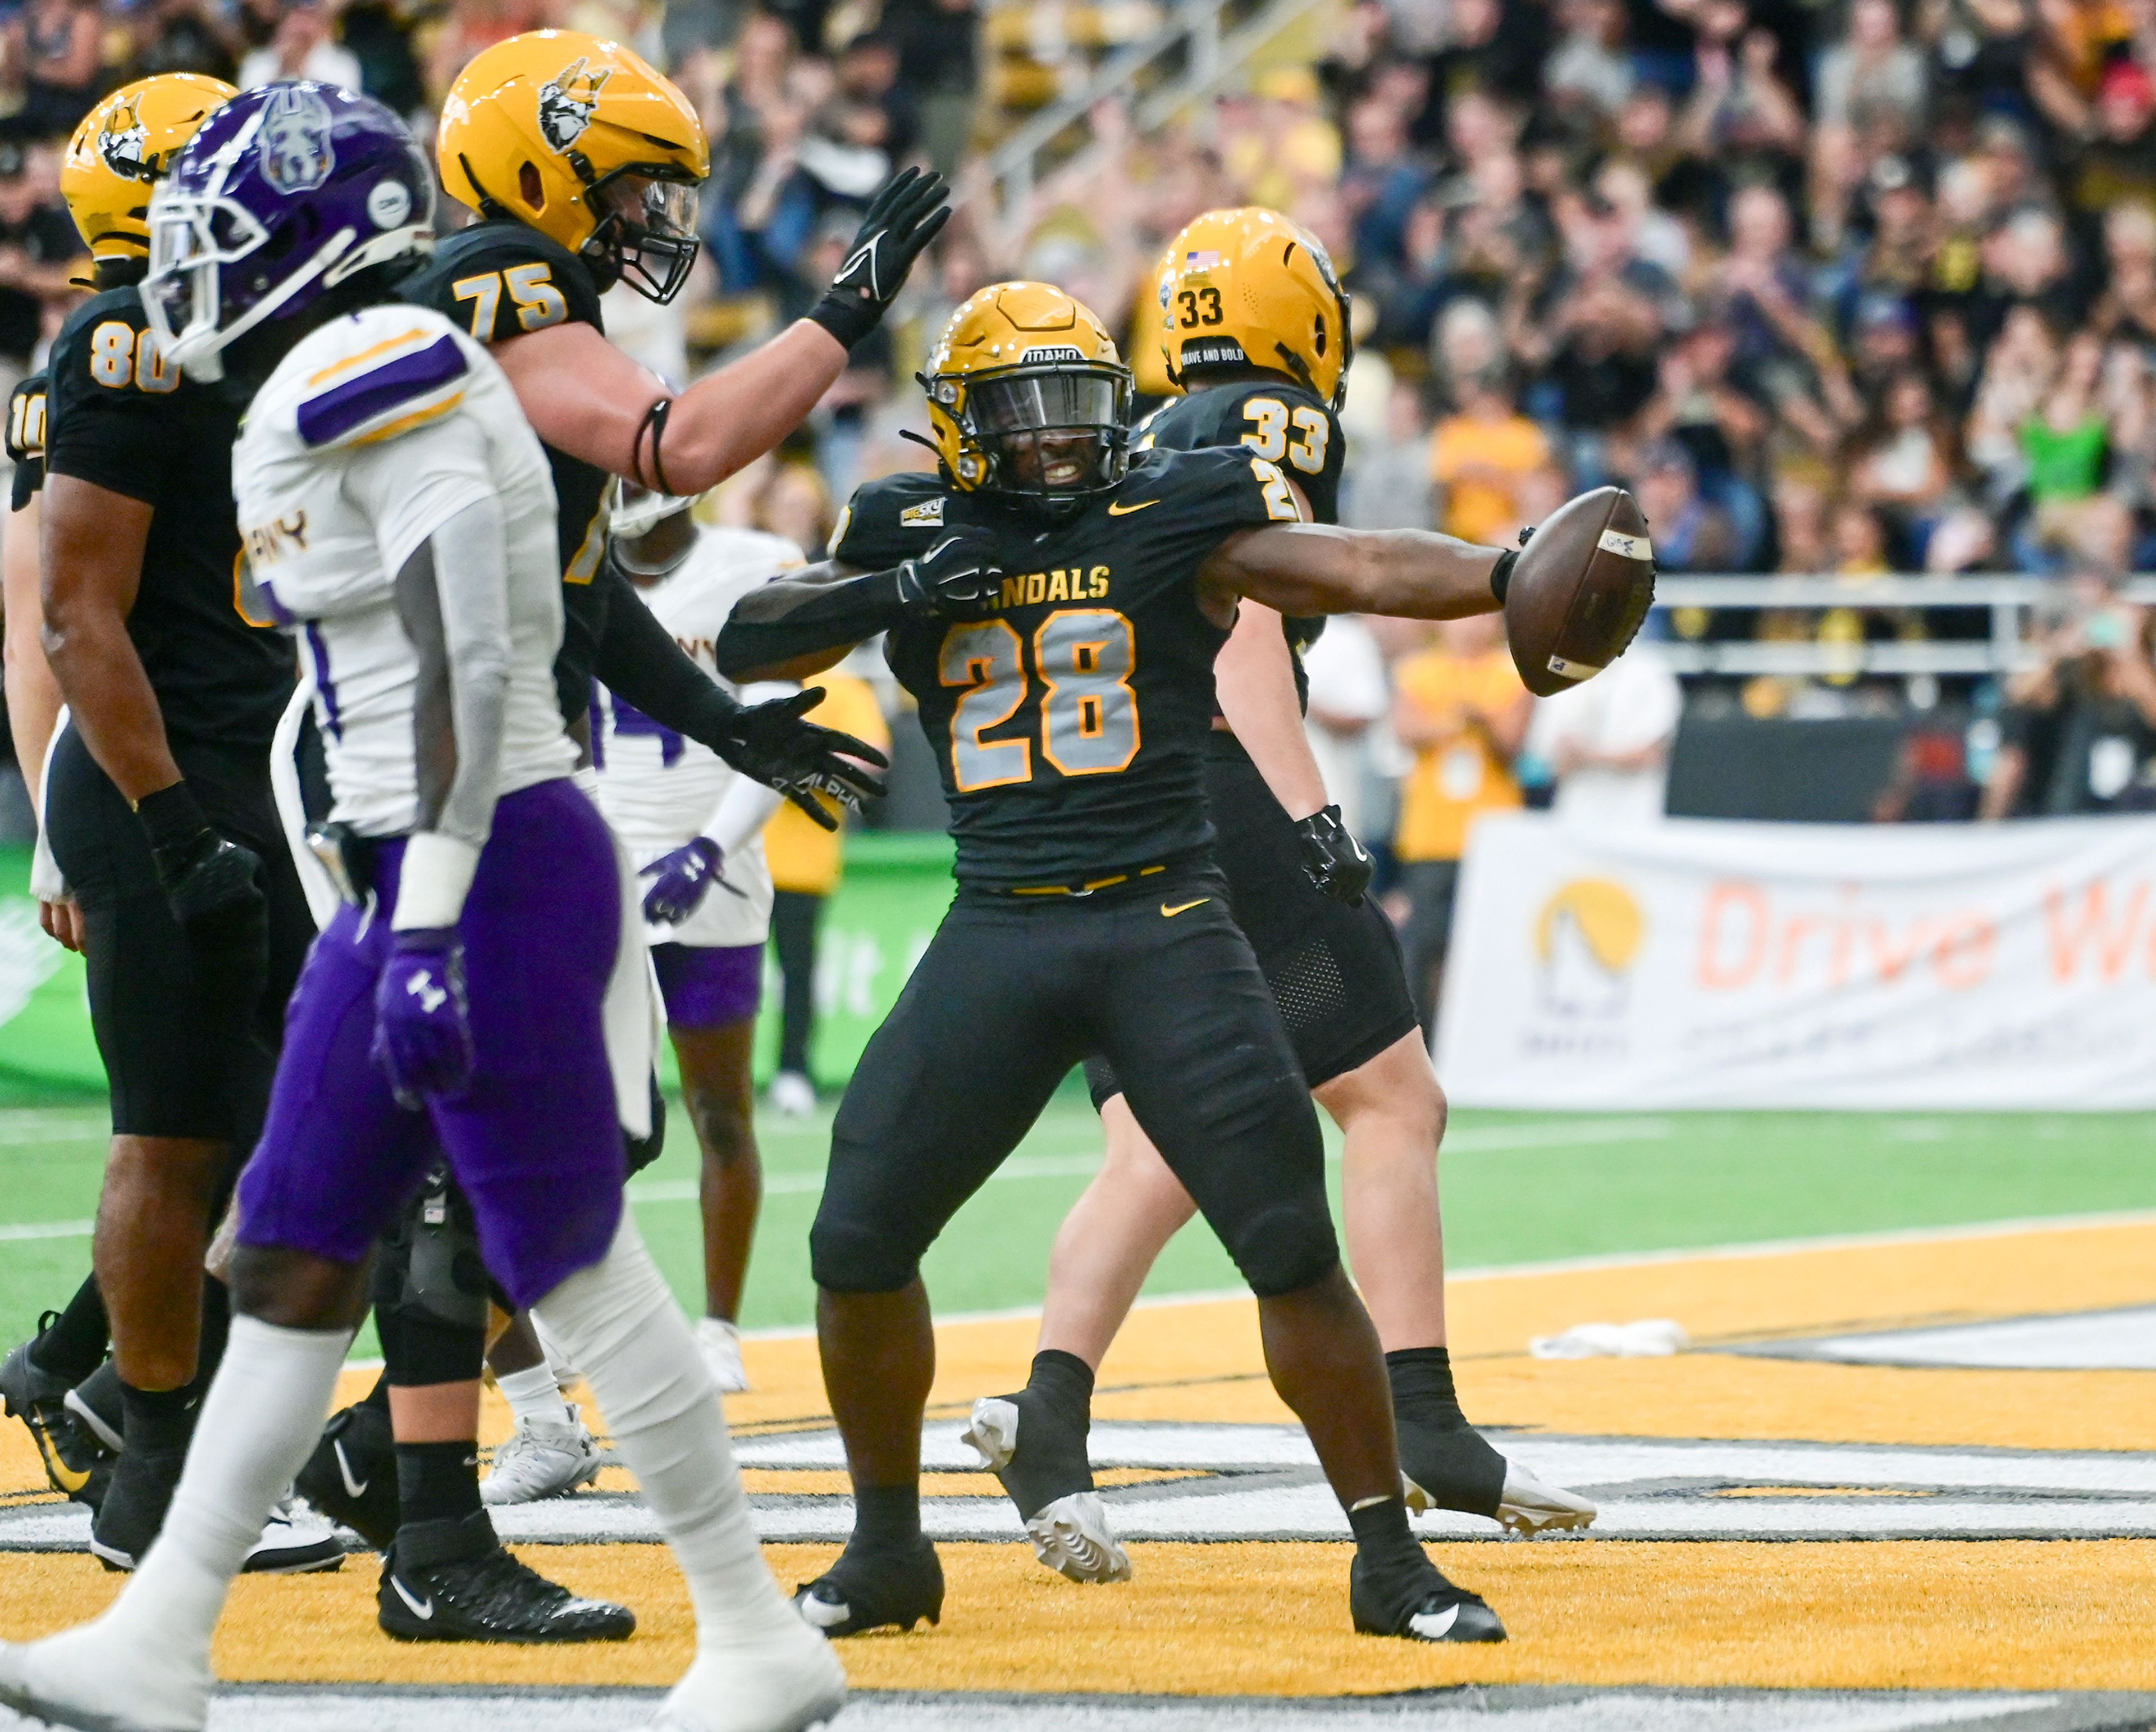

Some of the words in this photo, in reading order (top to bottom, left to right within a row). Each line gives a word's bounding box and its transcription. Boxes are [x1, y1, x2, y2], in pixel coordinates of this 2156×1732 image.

[453, 262, 568, 343] 75
[1178, 288, 1223, 329] 33
[90, 320, 182, 394] 80
[1027, 349, 1077, 362] IDAHO
[1203, 349, 1219, 362] AND
[1221, 348, 1244, 361] BOLD
[1241, 398, 1329, 475] 33
[1250, 457, 1302, 522] 2
[981, 566, 1110, 610] NDALS
[938, 608, 1141, 793] 28
[1696, 877, 2000, 991] Drive
[2041, 877, 2156, 986] W
